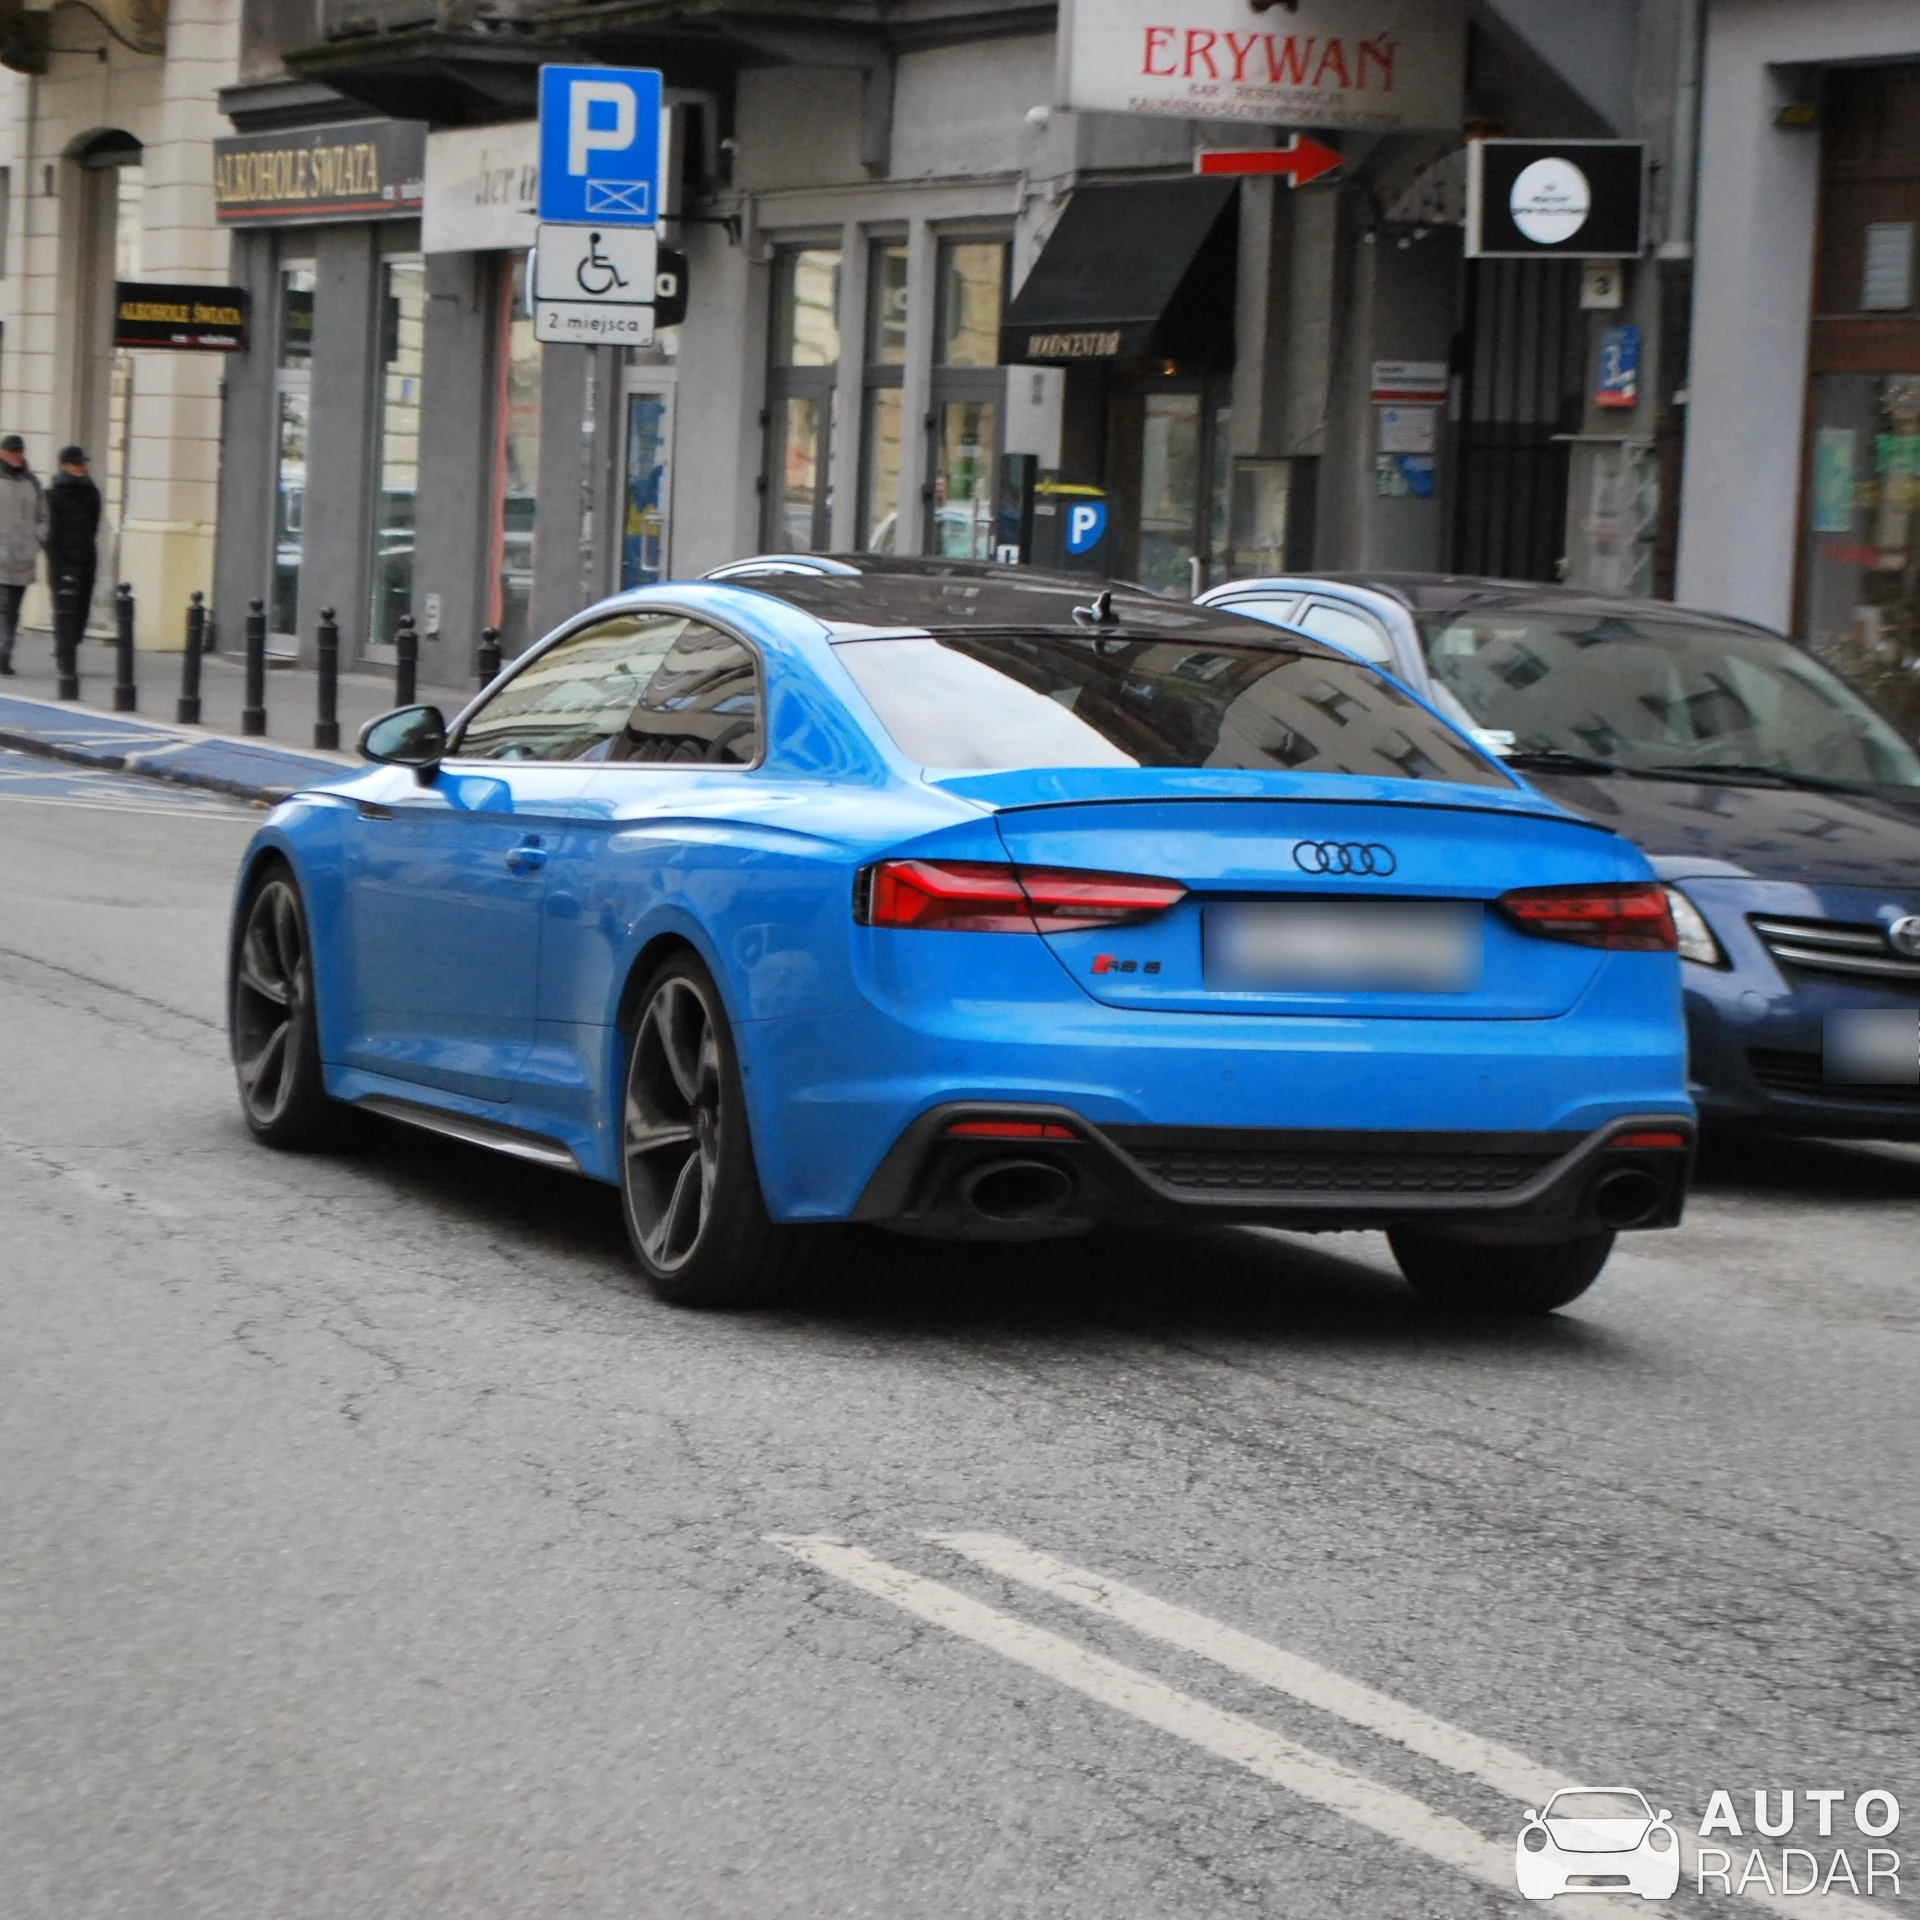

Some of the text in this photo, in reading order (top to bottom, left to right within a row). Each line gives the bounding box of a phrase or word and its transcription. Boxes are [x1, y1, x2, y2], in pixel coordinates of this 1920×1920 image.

[1141, 26, 1397, 92] ERYWAŃ
[567, 80, 637, 176] P
[217, 150, 308, 202] ALKOHOLE
[310, 136, 378, 196] ŚWIATA
[548, 313, 639, 334] 2 miejsca
[1072, 506, 1097, 544] P
